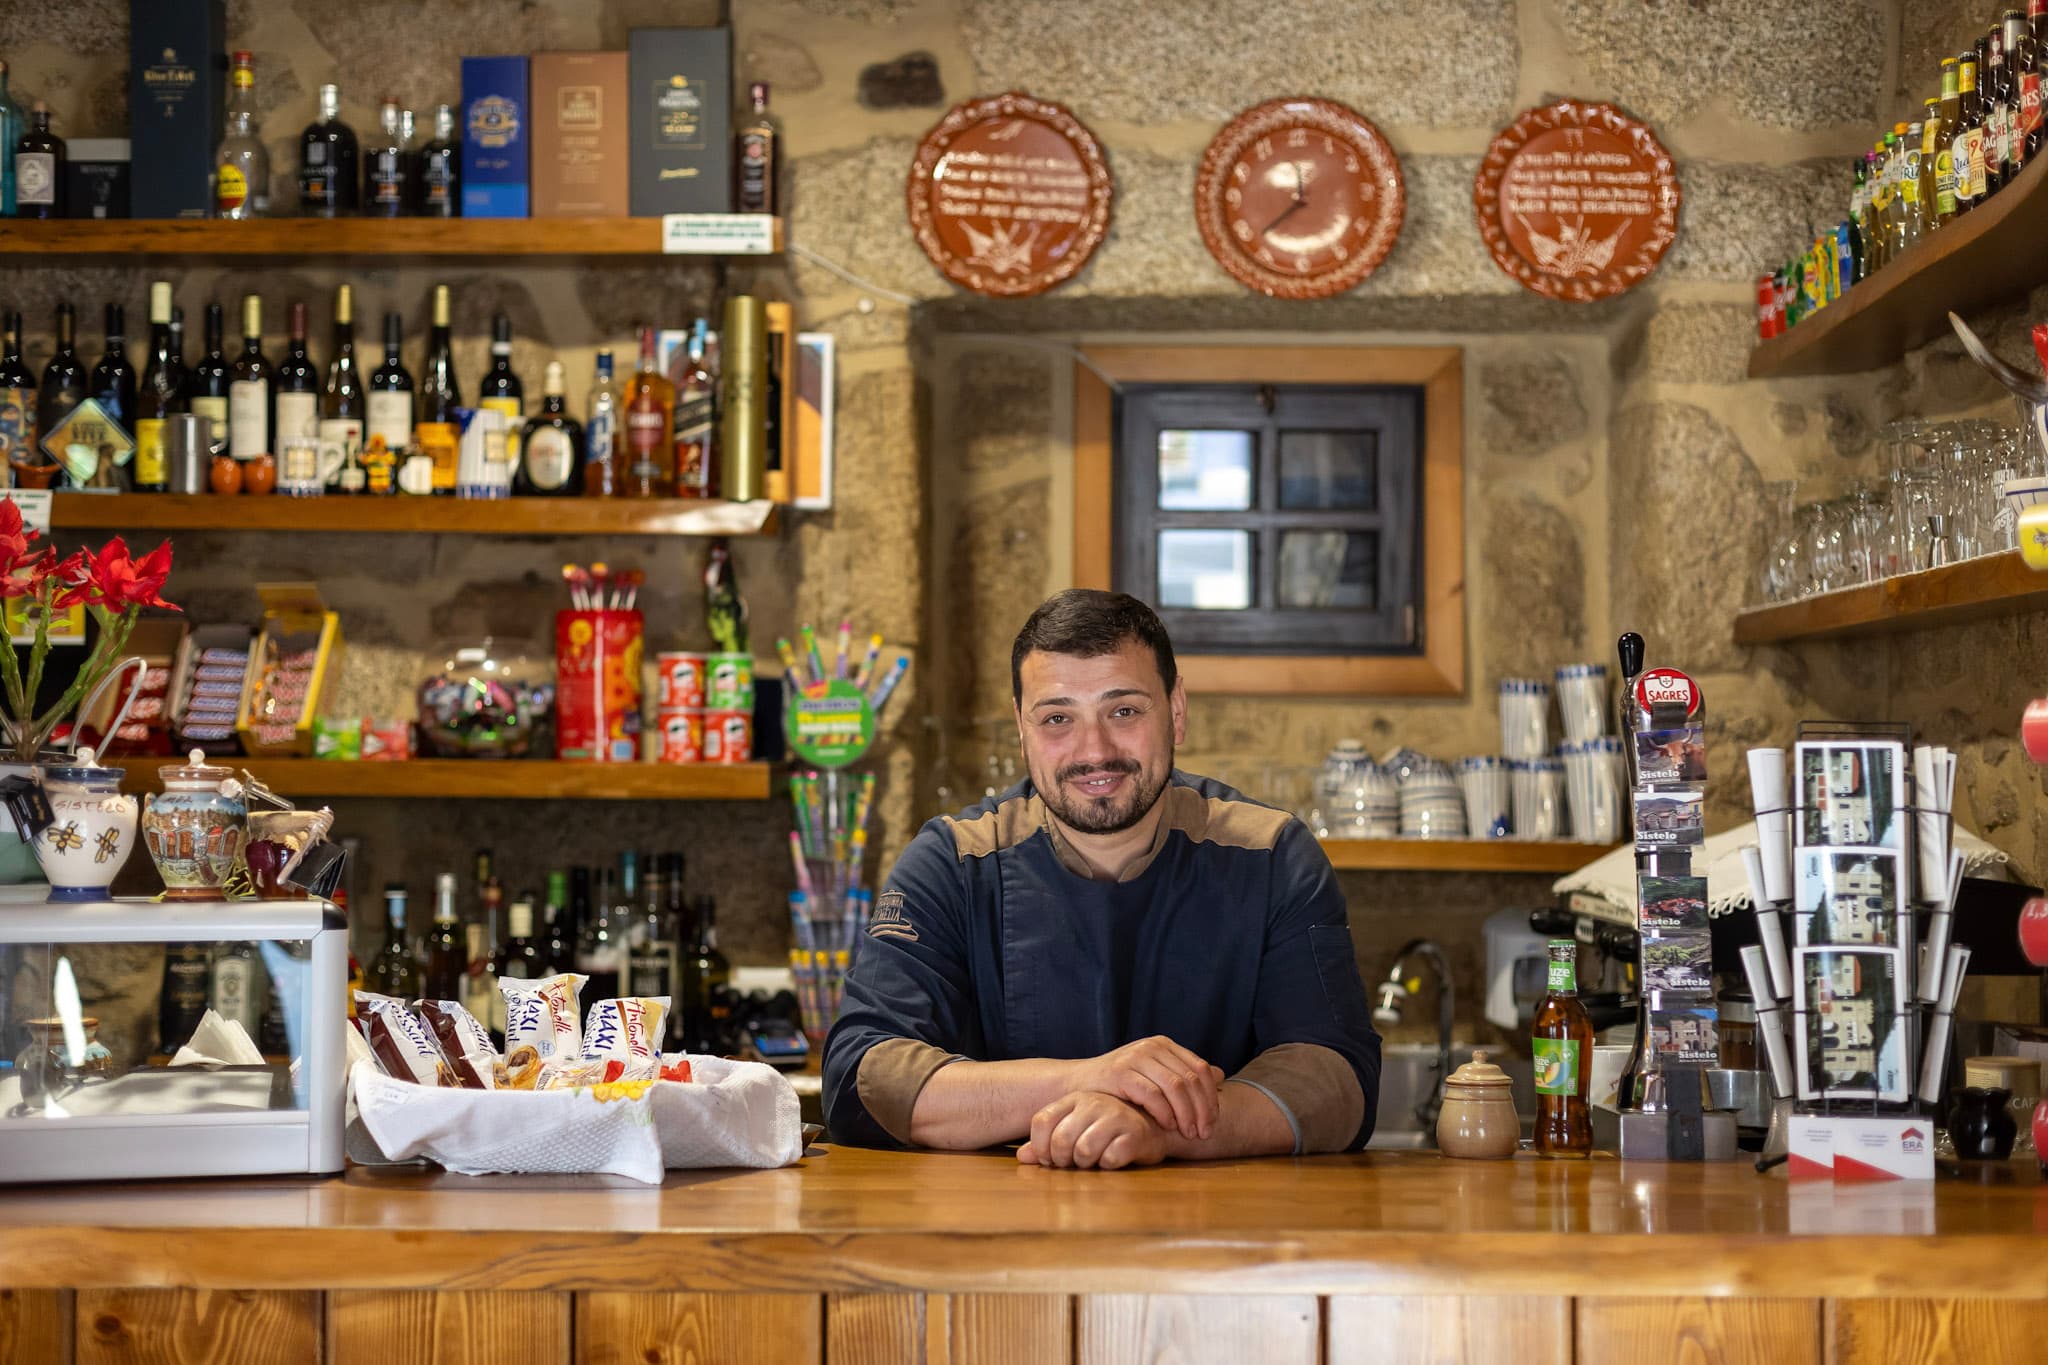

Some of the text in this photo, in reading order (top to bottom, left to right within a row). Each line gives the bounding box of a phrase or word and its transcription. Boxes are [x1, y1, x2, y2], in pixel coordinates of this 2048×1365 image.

[1648, 690, 1689, 702] SAGRES
[1640, 769, 1680, 779] Sistelo
[55, 800, 126, 814] SISTELO
[1636, 831, 1678, 840] Sistelo
[1640, 918, 1681, 926] Sistelo
[1670, 977, 1711, 987] Sistelo
[594, 1004, 618, 1051] MAXI
[1678, 1050, 1718, 1059] Sistelo
[2012, 1097, 2036, 1110] CAF
[1902, 1140, 1924, 1149] ERA
